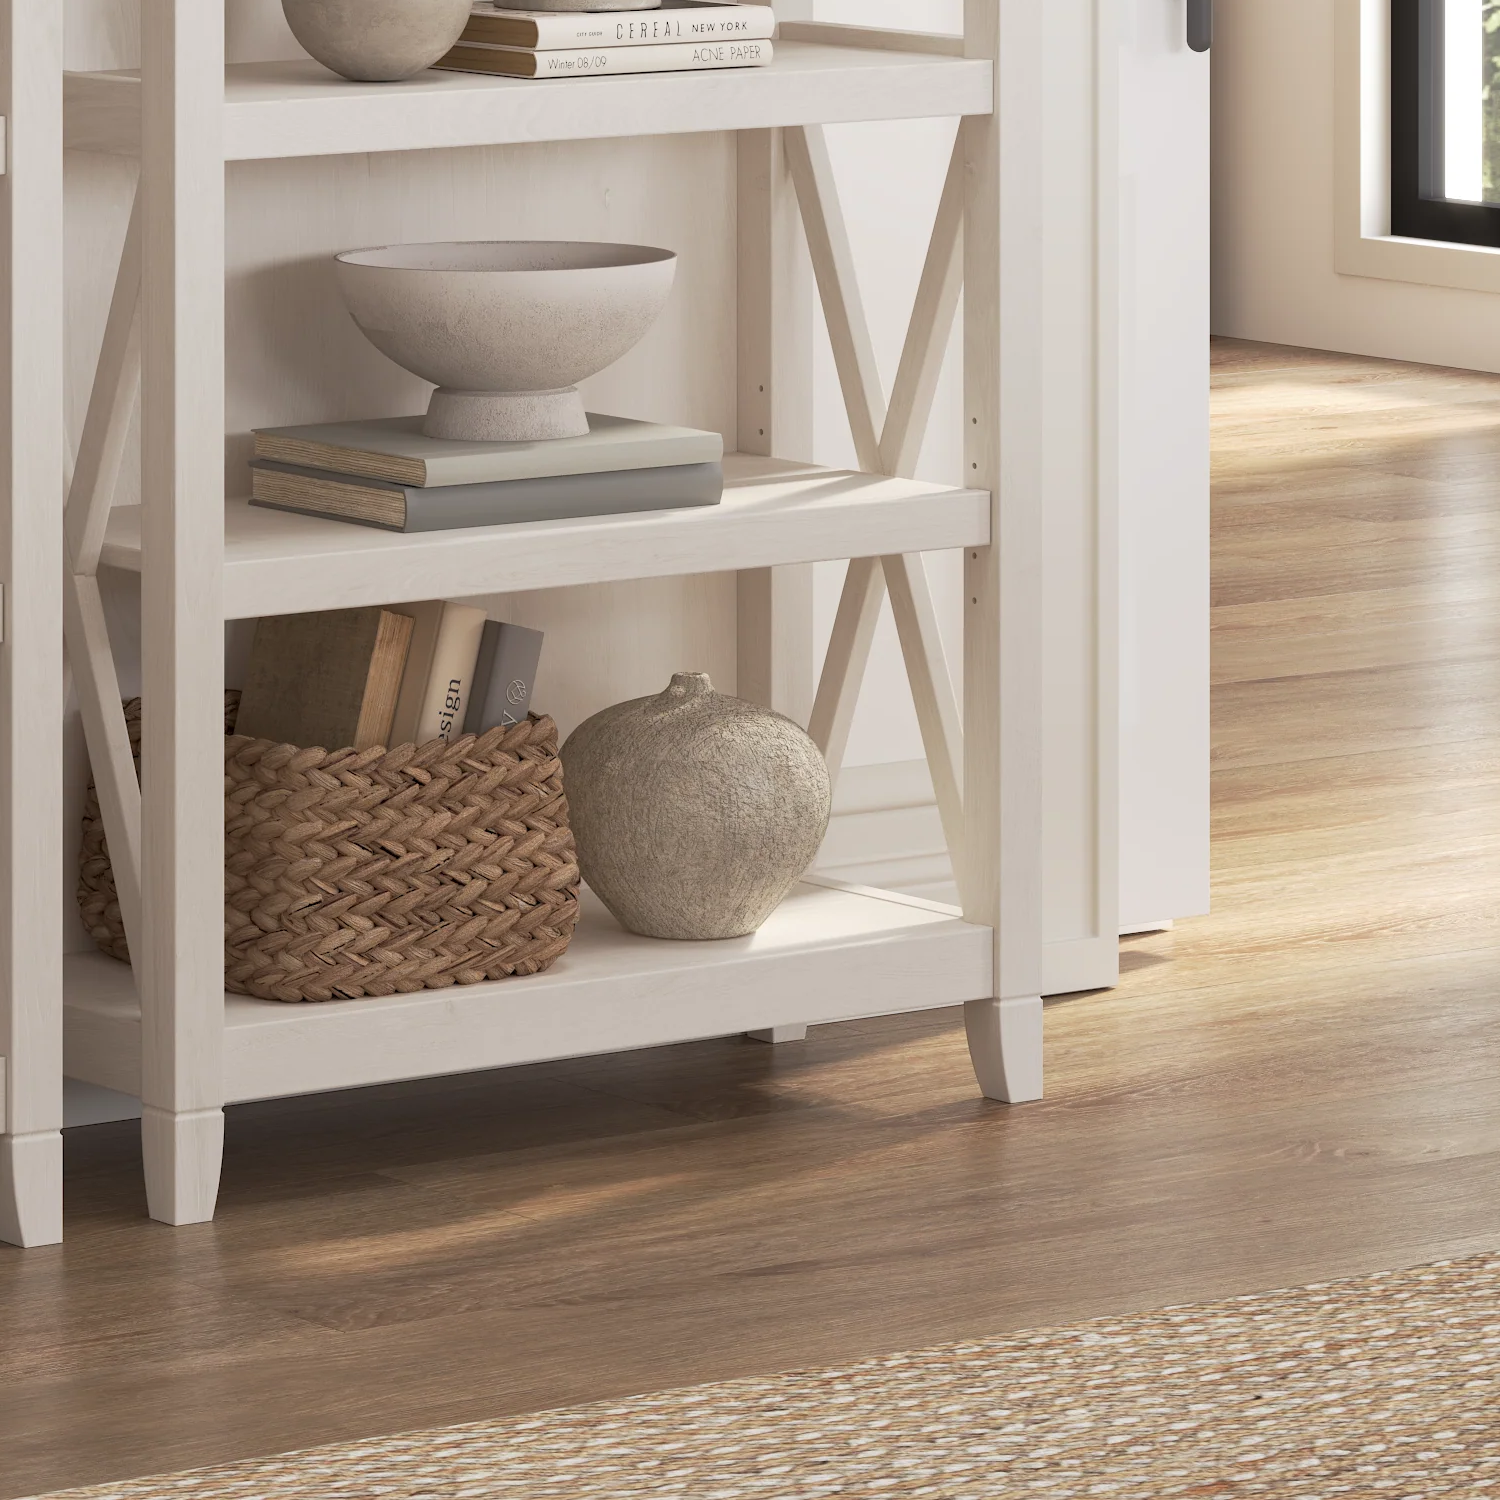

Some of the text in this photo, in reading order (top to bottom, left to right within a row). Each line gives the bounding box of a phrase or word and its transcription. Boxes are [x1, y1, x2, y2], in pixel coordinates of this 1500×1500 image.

[616, 20, 682, 40] CEREAL
[691, 21, 748, 33] NEW YORK
[692, 45, 761, 62] ACNE PAPER
[547, 55, 608, 70] Winter 08/09
[438, 679, 462, 741] esign
